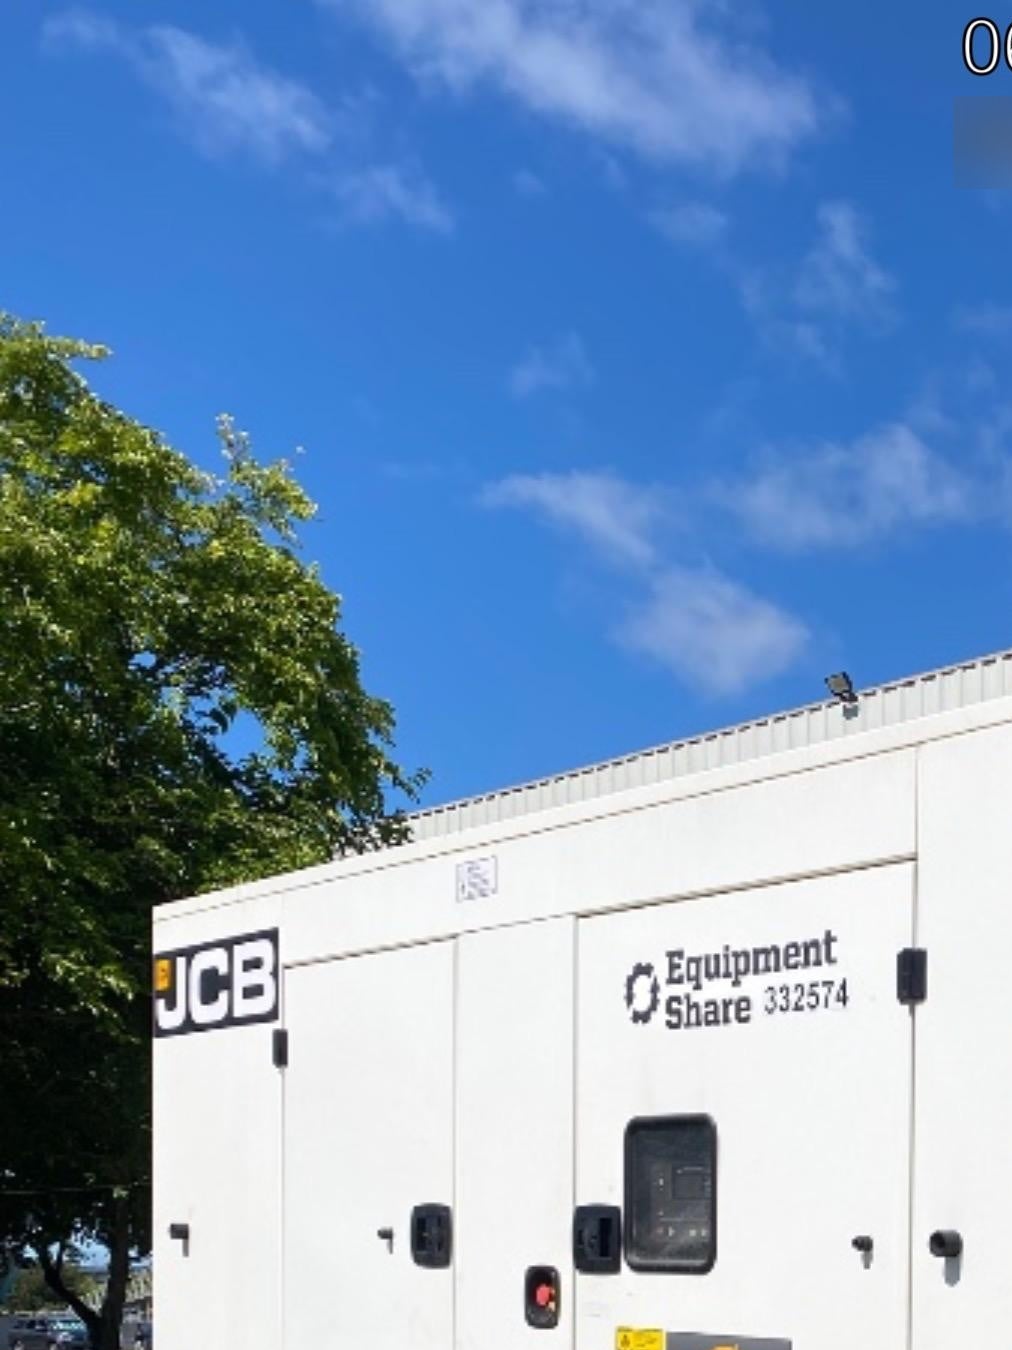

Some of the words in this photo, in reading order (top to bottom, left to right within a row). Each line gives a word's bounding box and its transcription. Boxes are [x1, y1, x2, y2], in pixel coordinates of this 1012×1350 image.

[155, 939, 277, 1030] JCB
[665, 929, 838, 990] Equipment
[665, 993, 751, 1029] Share
[764, 977, 849, 1015] 332574
